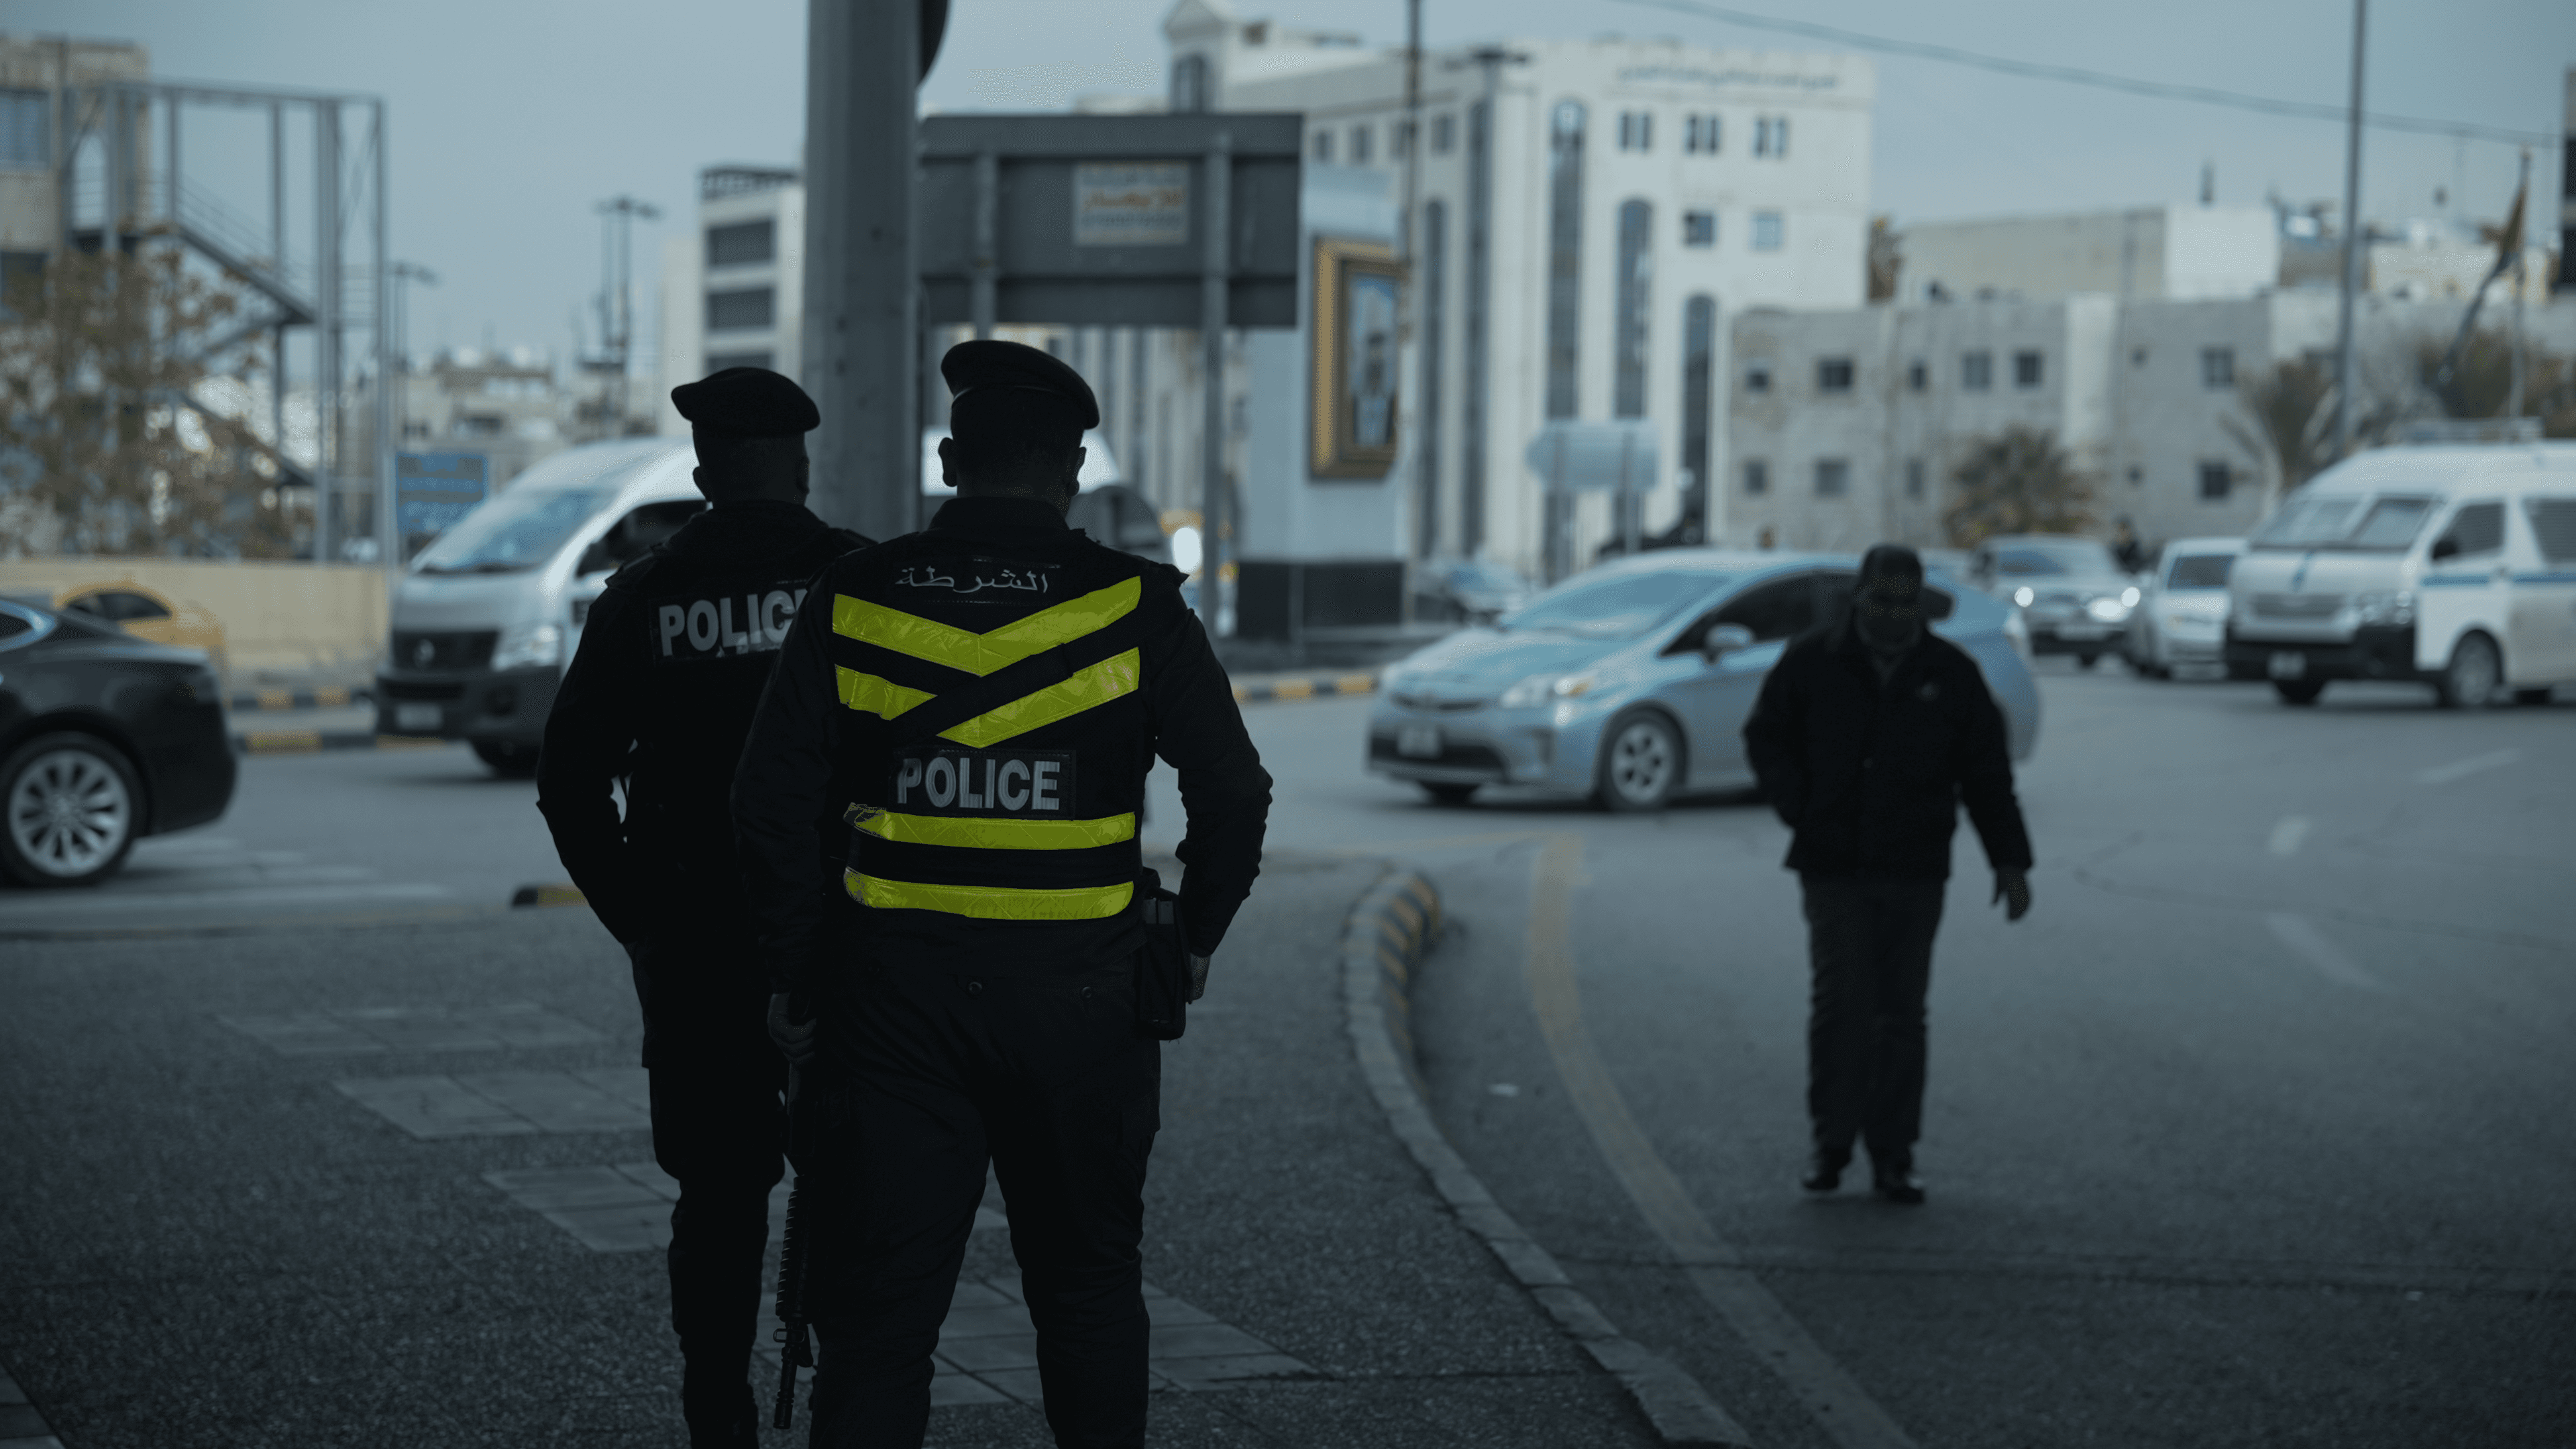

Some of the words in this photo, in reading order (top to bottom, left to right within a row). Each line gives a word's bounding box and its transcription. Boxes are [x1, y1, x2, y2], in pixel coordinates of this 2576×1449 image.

[895, 566, 1049, 594] الشرطة
[659, 588, 808, 657] POLIC
[897, 756, 1061, 811] POLICE
